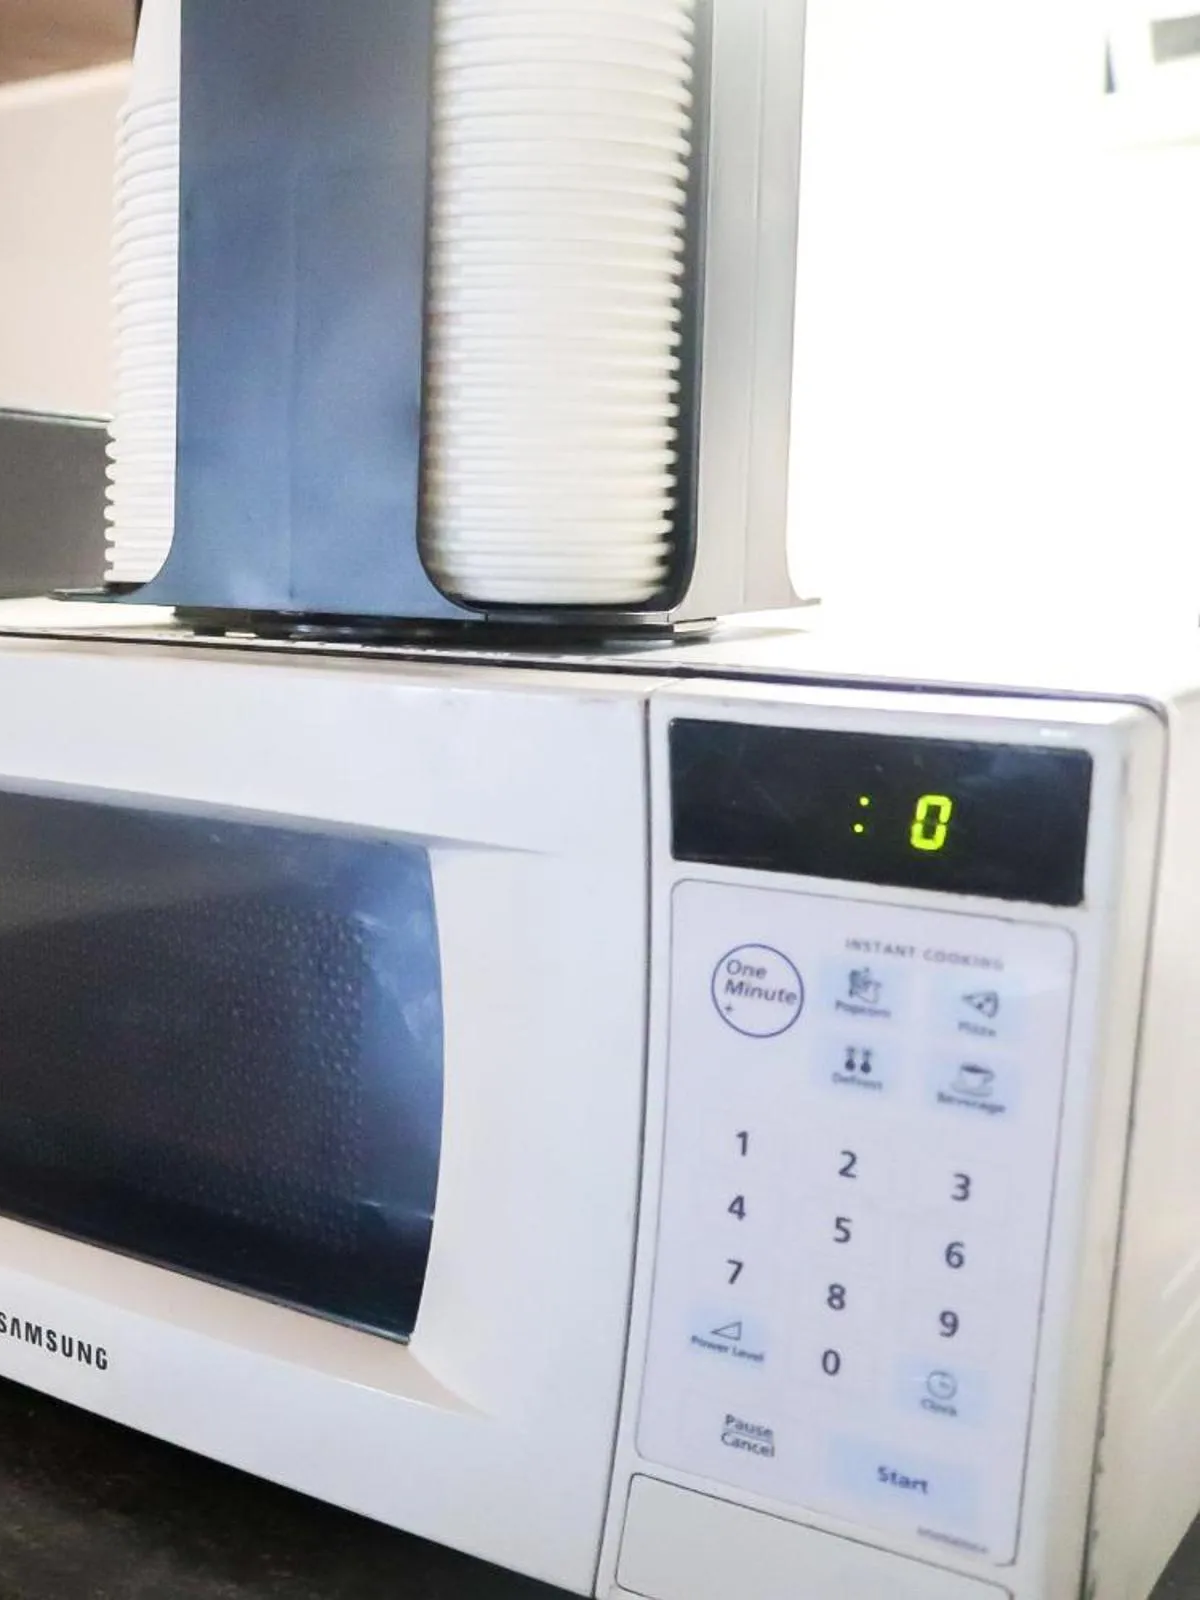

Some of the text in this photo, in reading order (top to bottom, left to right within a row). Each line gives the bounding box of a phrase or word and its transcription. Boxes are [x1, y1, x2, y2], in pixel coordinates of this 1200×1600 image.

[845, 938, 916, 958] INSTANT
[727, 959, 767, 979] One
[725, 979, 797, 1005] Minute
[736, 1130, 749, 1157] 1
[837, 1149, 858, 1179] 2
[951, 1172, 972, 1202] 3
[727, 1194, 747, 1221] 4
[833, 1215, 852, 1244] 5
[944, 1240, 965, 1270] 6
[727, 1259, 744, 1285] 7
[826, 1282, 847, 1312] 8
[938, 1310, 960, 1339] 9
[821, 1348, 842, 1377] 0
[725, 1413, 773, 1437] Pause
[721, 1430, 775, 1457] Cancel
[877, 1465, 929, 1495] Start
